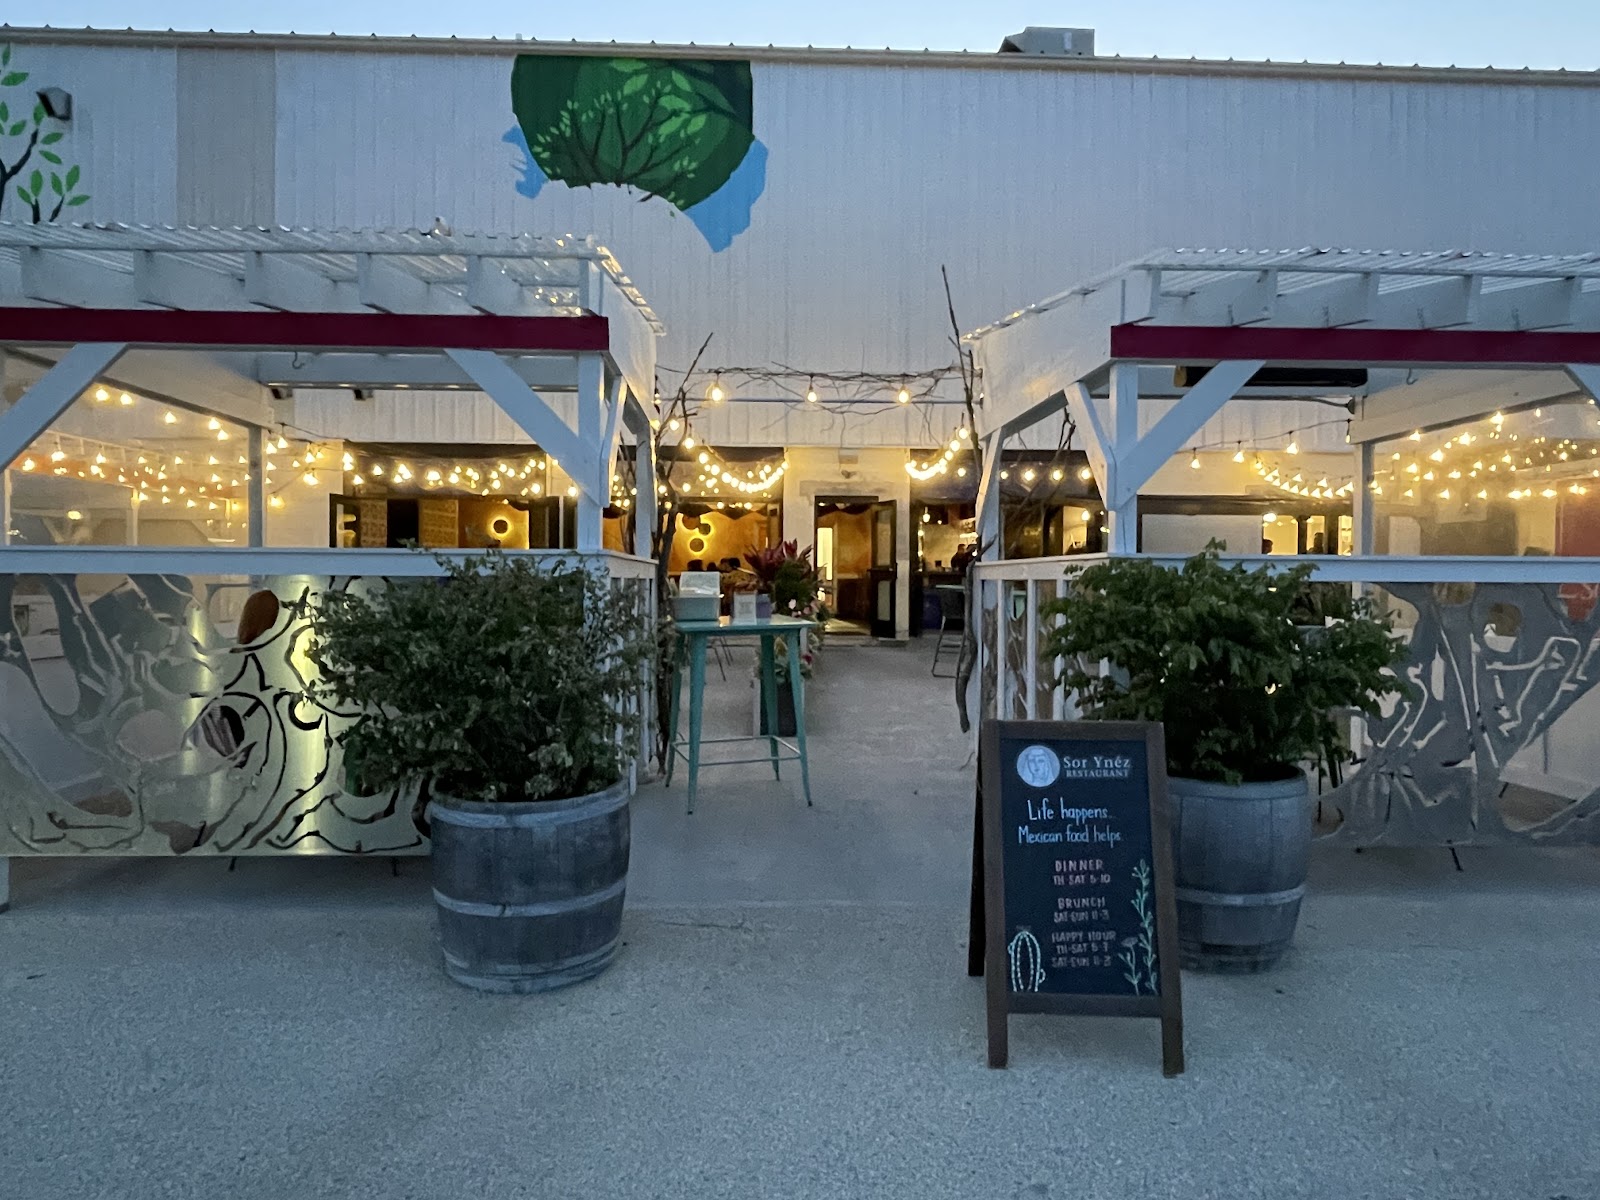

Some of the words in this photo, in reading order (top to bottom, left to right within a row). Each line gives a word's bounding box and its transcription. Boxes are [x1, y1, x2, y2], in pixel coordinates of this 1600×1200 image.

[1063, 756, 1087, 769] Sor
[1093, 755, 1131, 769] Ynéz
[1066, 768, 1129, 778] RESTAURANT
[1027, 798, 1054, 821] Life
[1018, 825, 1063, 844] Mexican
[1066, 824, 1089, 843] food
[1055, 859, 1104, 872] DINNER
[1057, 896, 1106, 910] BRUNCH
[1051, 931, 1083, 943] HAPPY
[1088, 930, 1116, 941] HOUR
